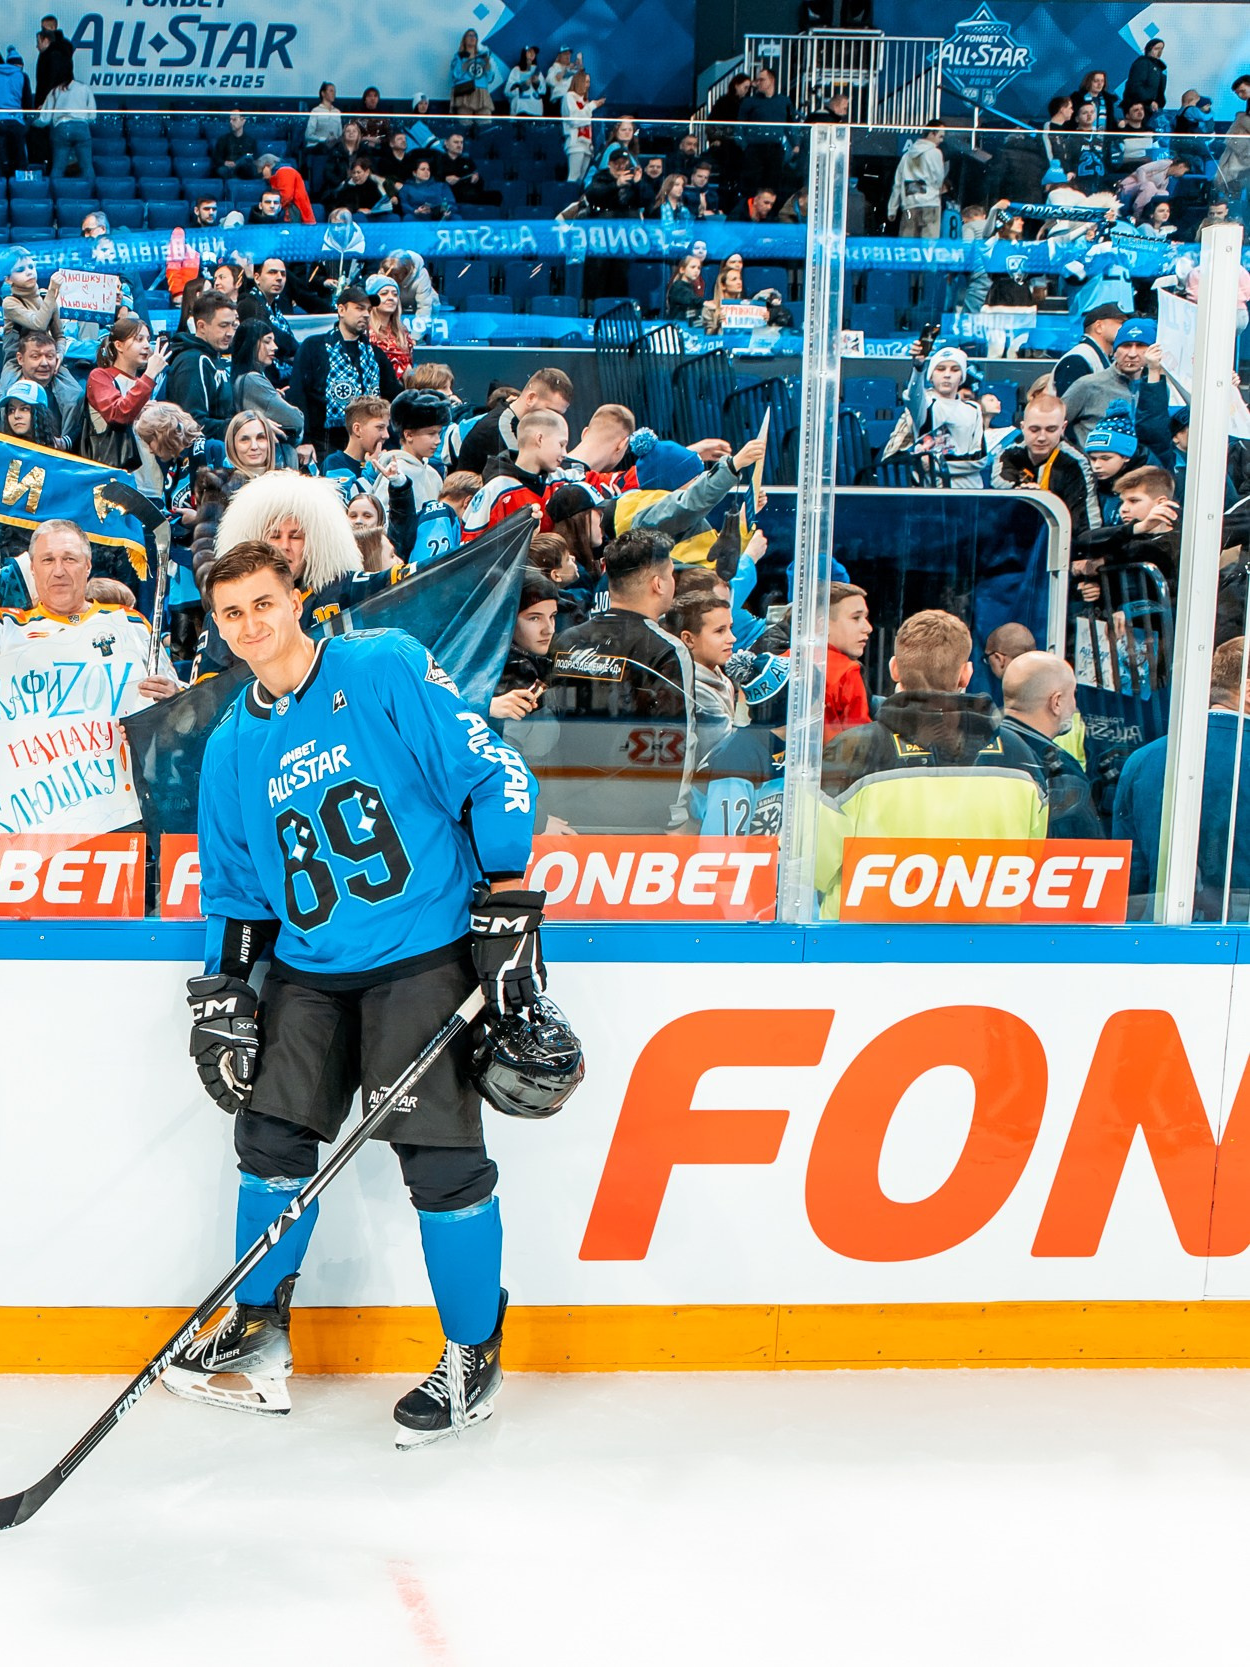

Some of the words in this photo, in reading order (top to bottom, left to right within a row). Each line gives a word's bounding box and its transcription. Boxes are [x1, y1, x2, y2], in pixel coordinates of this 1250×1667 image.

[963, 34, 1001, 43] FONBET
[275, 777, 416, 935] 89
[523, 851, 771, 906] ONBET
[845, 854, 1125, 909] FONBET
[239, 924, 252, 964] NOVOSI
[470, 914, 530, 934] CM
[191, 997, 238, 1021] CM
[149, 1317, 202, 1378] TIMER
